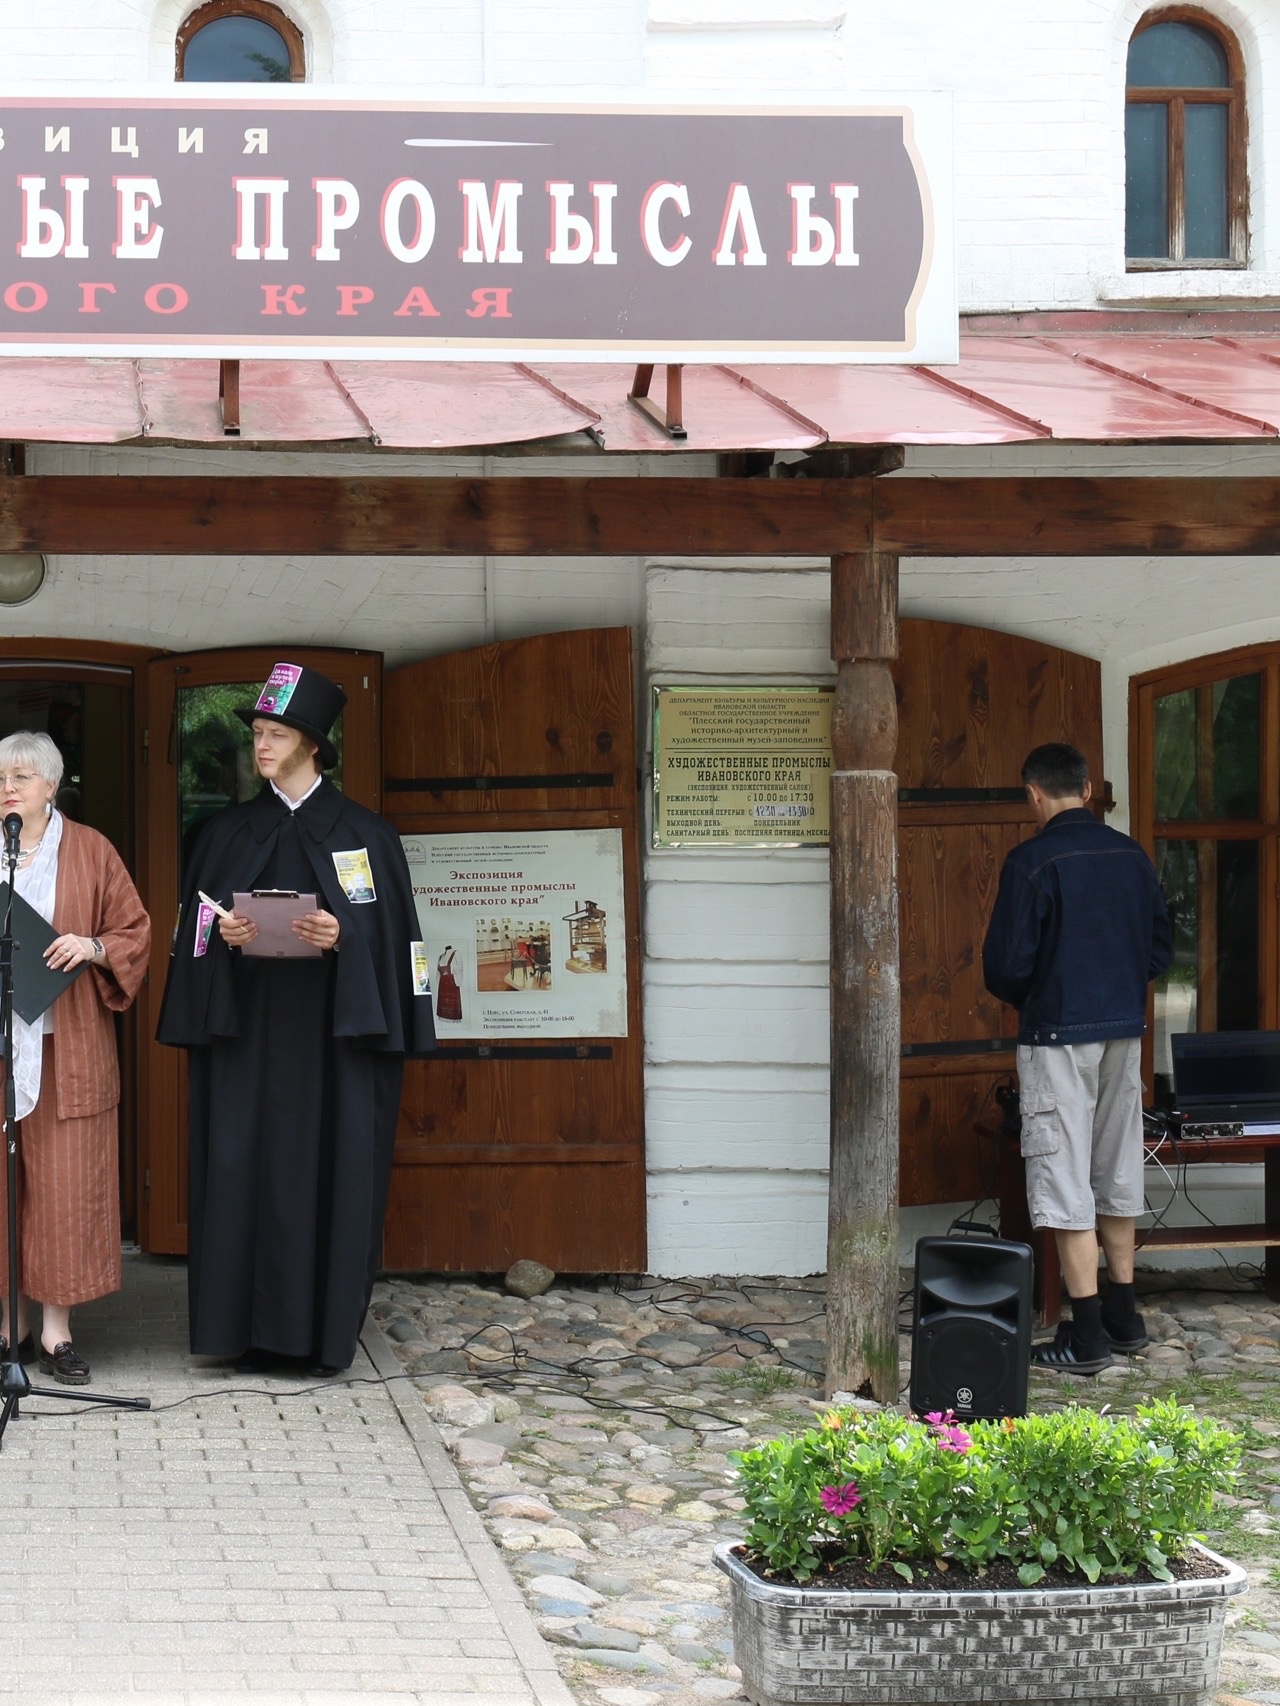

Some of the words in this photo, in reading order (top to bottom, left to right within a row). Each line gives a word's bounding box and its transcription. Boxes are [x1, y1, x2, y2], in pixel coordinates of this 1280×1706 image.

[232, 175, 861, 268] ПРОМЫСЛЫ
[260, 284, 514, 318] КРАЯ
[736, 718, 810, 726] государственный
[692, 727, 800, 735] историко-архитектурный
[672, 736, 744, 744] художественный
[668, 757, 768, 769] ХУДОЖЕСТВЕННЫЕ
[772, 757, 831, 769] ПРОМЫСЛЫ
[698, 771, 771, 781] ИВАНОВСКОГО
[775, 771, 801, 781] КРАЯ
[754, 793, 777, 801] 10.00
[790, 793, 814, 801] 17.30
[667, 808, 714, 816] ТЕХНИЧЕСКИЙ
[667, 819, 702, 827] ВЫХОДНОЙ
[449, 870, 523, 880] Экспозиция
[412, 884, 507, 896] удожественные
[511, 883, 576, 894] промыслы
[429, 896, 507, 907] Ивановского
